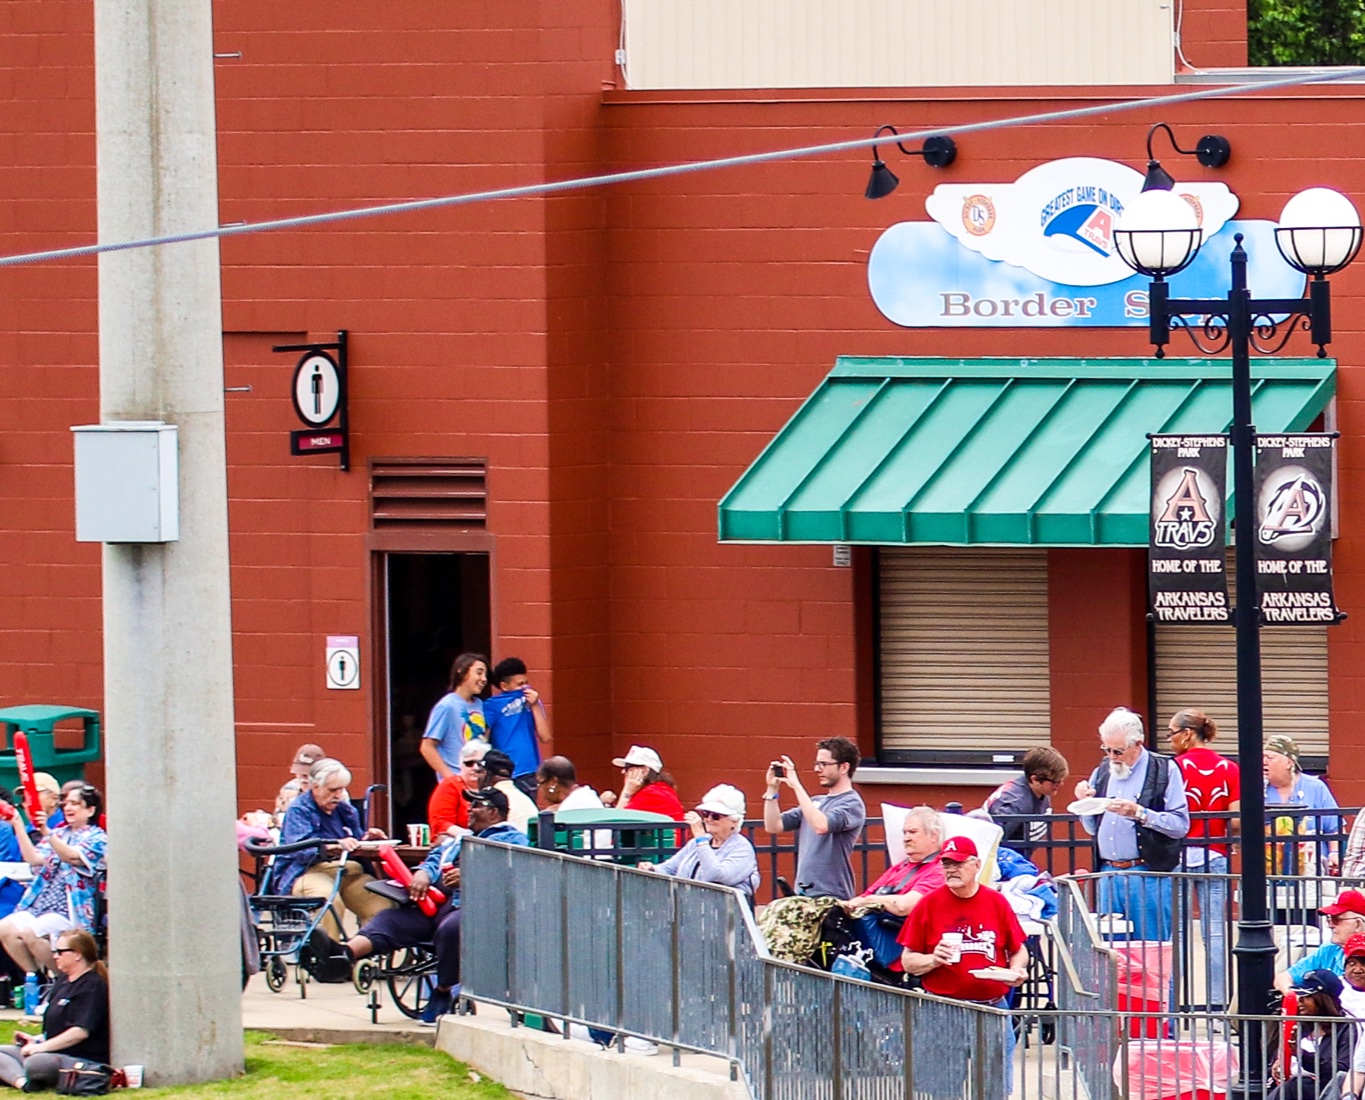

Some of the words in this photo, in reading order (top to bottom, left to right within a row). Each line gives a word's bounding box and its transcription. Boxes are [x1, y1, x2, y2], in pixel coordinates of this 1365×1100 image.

[939, 292, 1097, 318] Border
[1152, 437, 1226, 448] DICKEY-STEPHENS
[1257, 437, 1331, 448] DICKEY-STEPHENS
[1177, 448, 1201, 458] PARK
[1282, 448, 1305, 458] PARK
[1157, 521, 1213, 545] TRAVS
[1152, 560, 1182, 573] HOME
[1183, 561, 1197, 573] OF
[1199, 560, 1222, 573] THE
[1257, 560, 1287, 574] HOME
[1288, 561, 1303, 574] OF
[1304, 561, 1328, 574] THE
[1156, 592, 1226, 607] ARKANSAS
[1262, 593, 1332, 608] ARKANSAS
[1155, 607, 1228, 621] TRAVELERS
[1263, 607, 1334, 622] TRAVELERS
